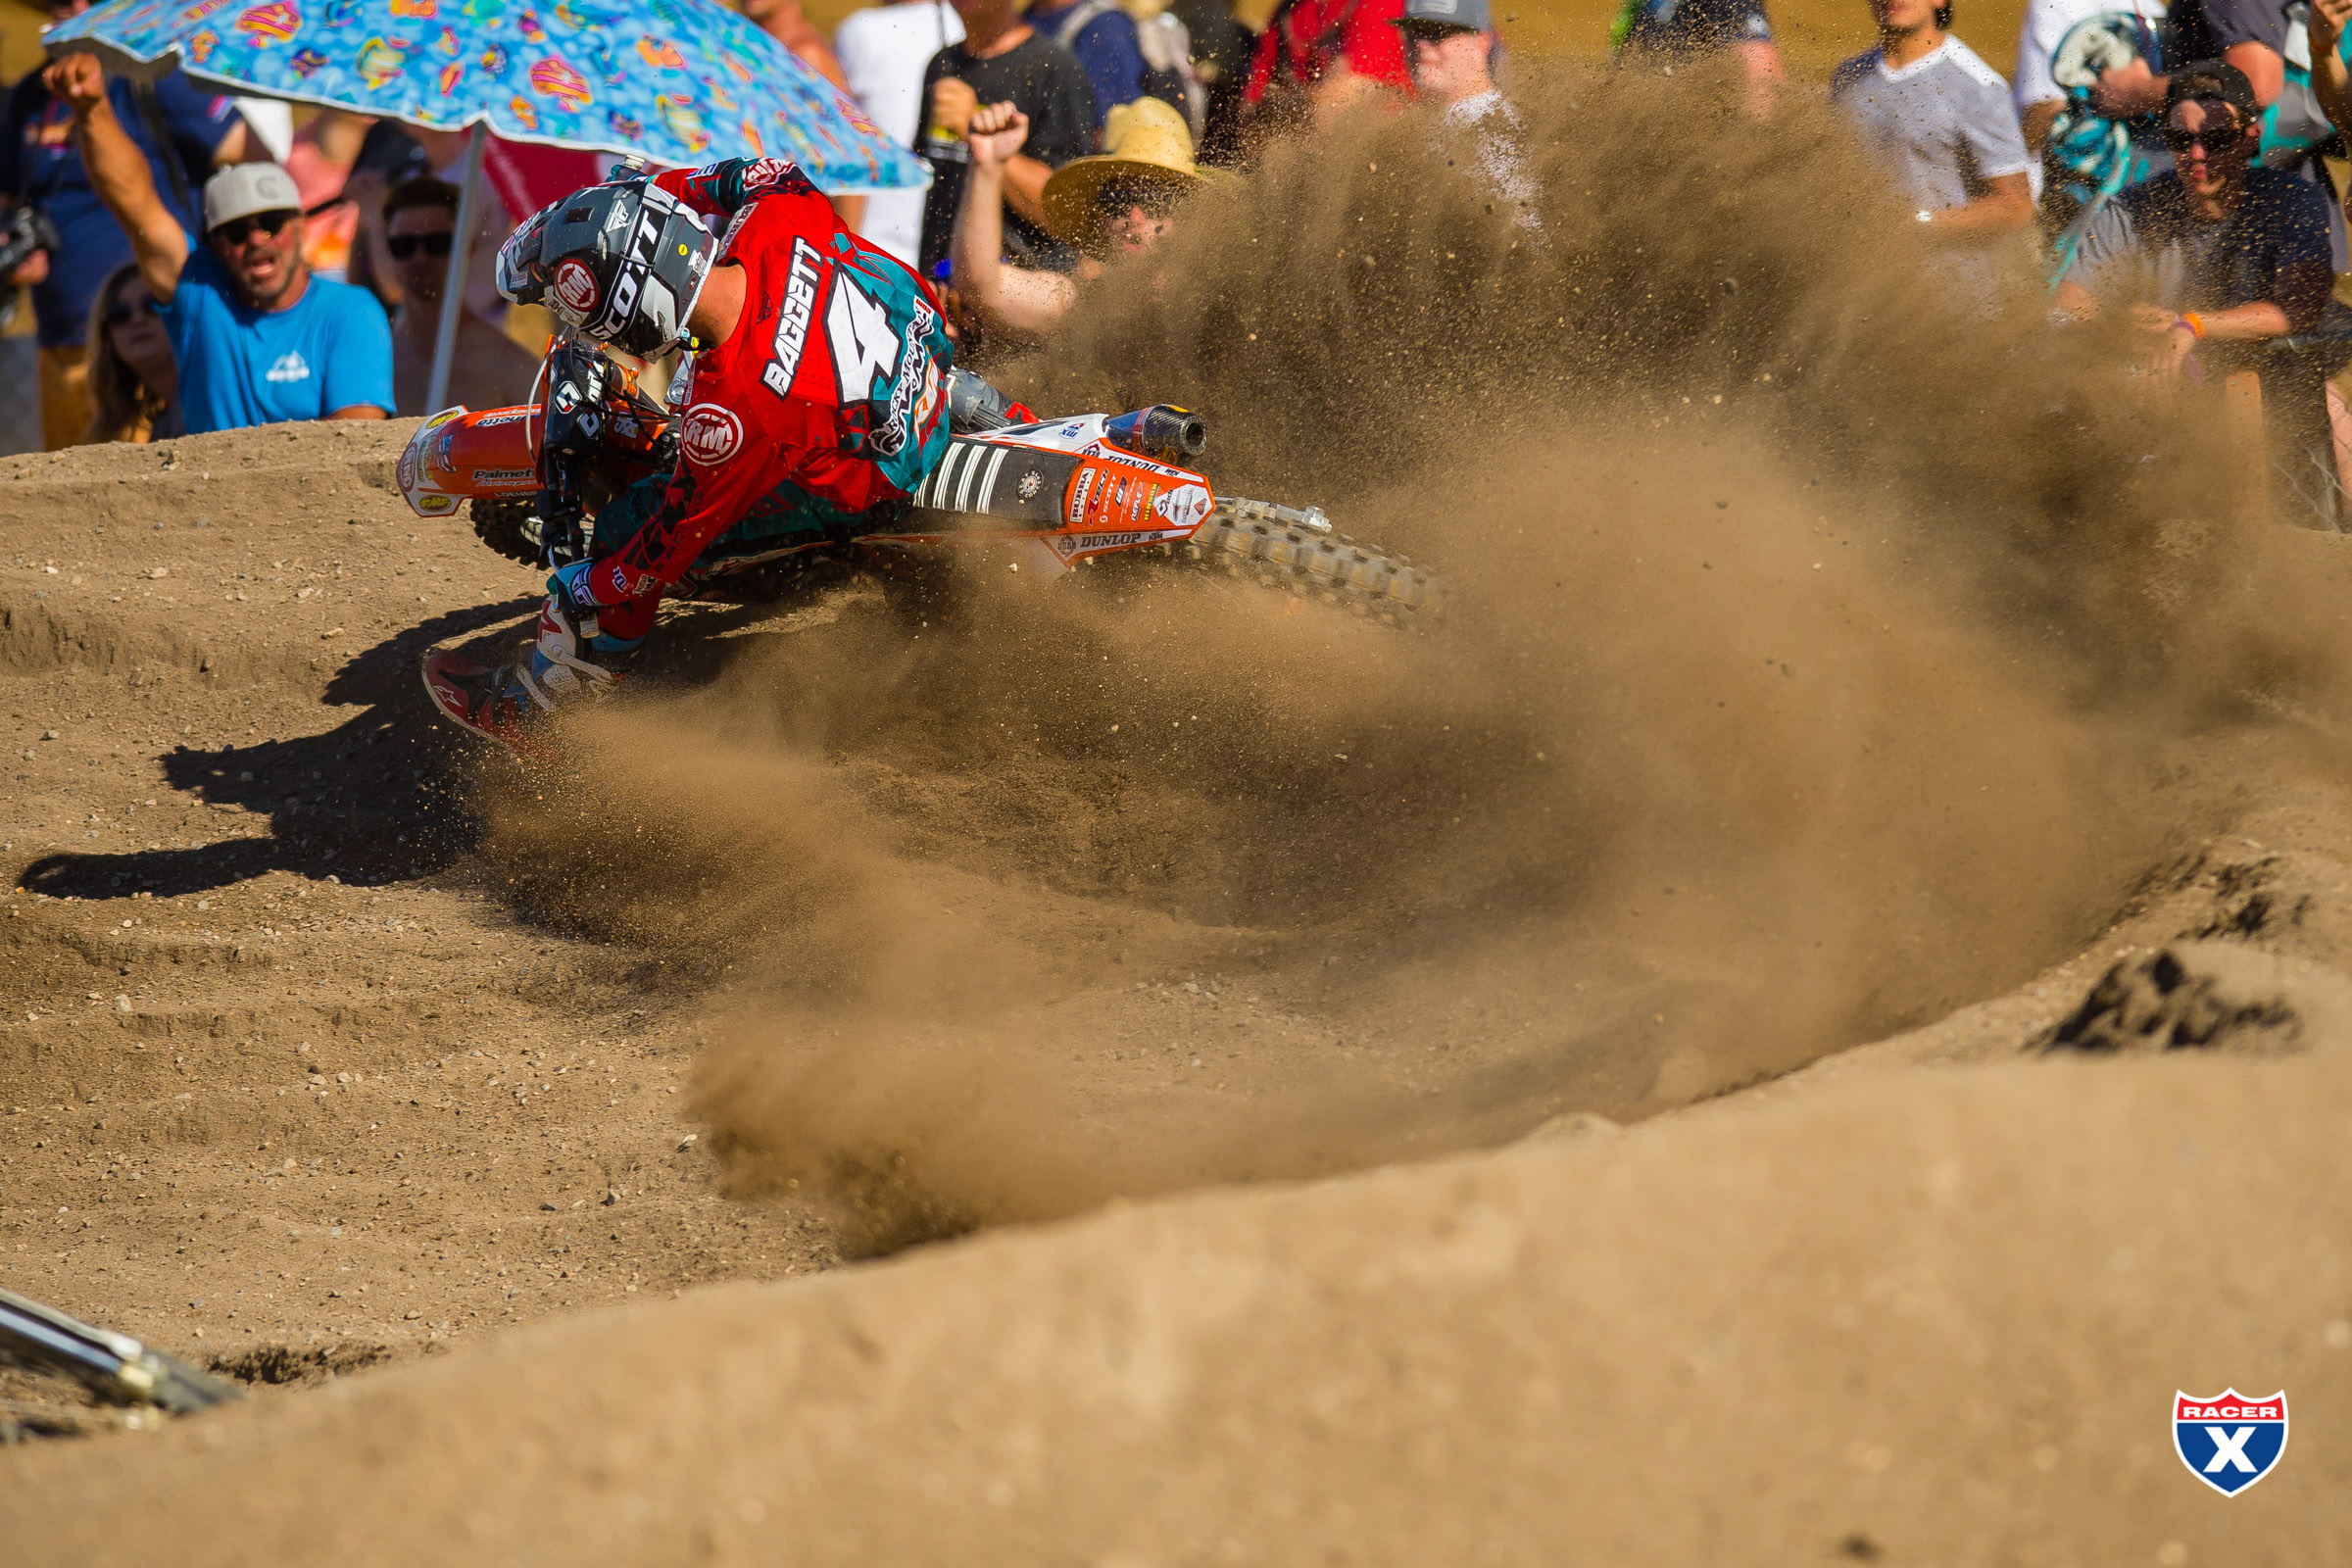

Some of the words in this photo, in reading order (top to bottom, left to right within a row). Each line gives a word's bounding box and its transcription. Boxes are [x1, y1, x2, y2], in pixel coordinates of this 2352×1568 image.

[590, 210, 659, 340] SCOTT
[763, 237, 822, 397] BAGGETT
[827, 271, 900, 403] 4
[887, 382, 904, 432] ROCKY
[473, 469, 535, 481] Palmet
[1072, 471, 1090, 518] BUBBA
[1103, 474, 1117, 513] SCOTT
[420, 497, 452, 509] FMF
[1145, 483, 1158, 520] HINSON
[1080, 533, 1141, 547] DUNLOP
